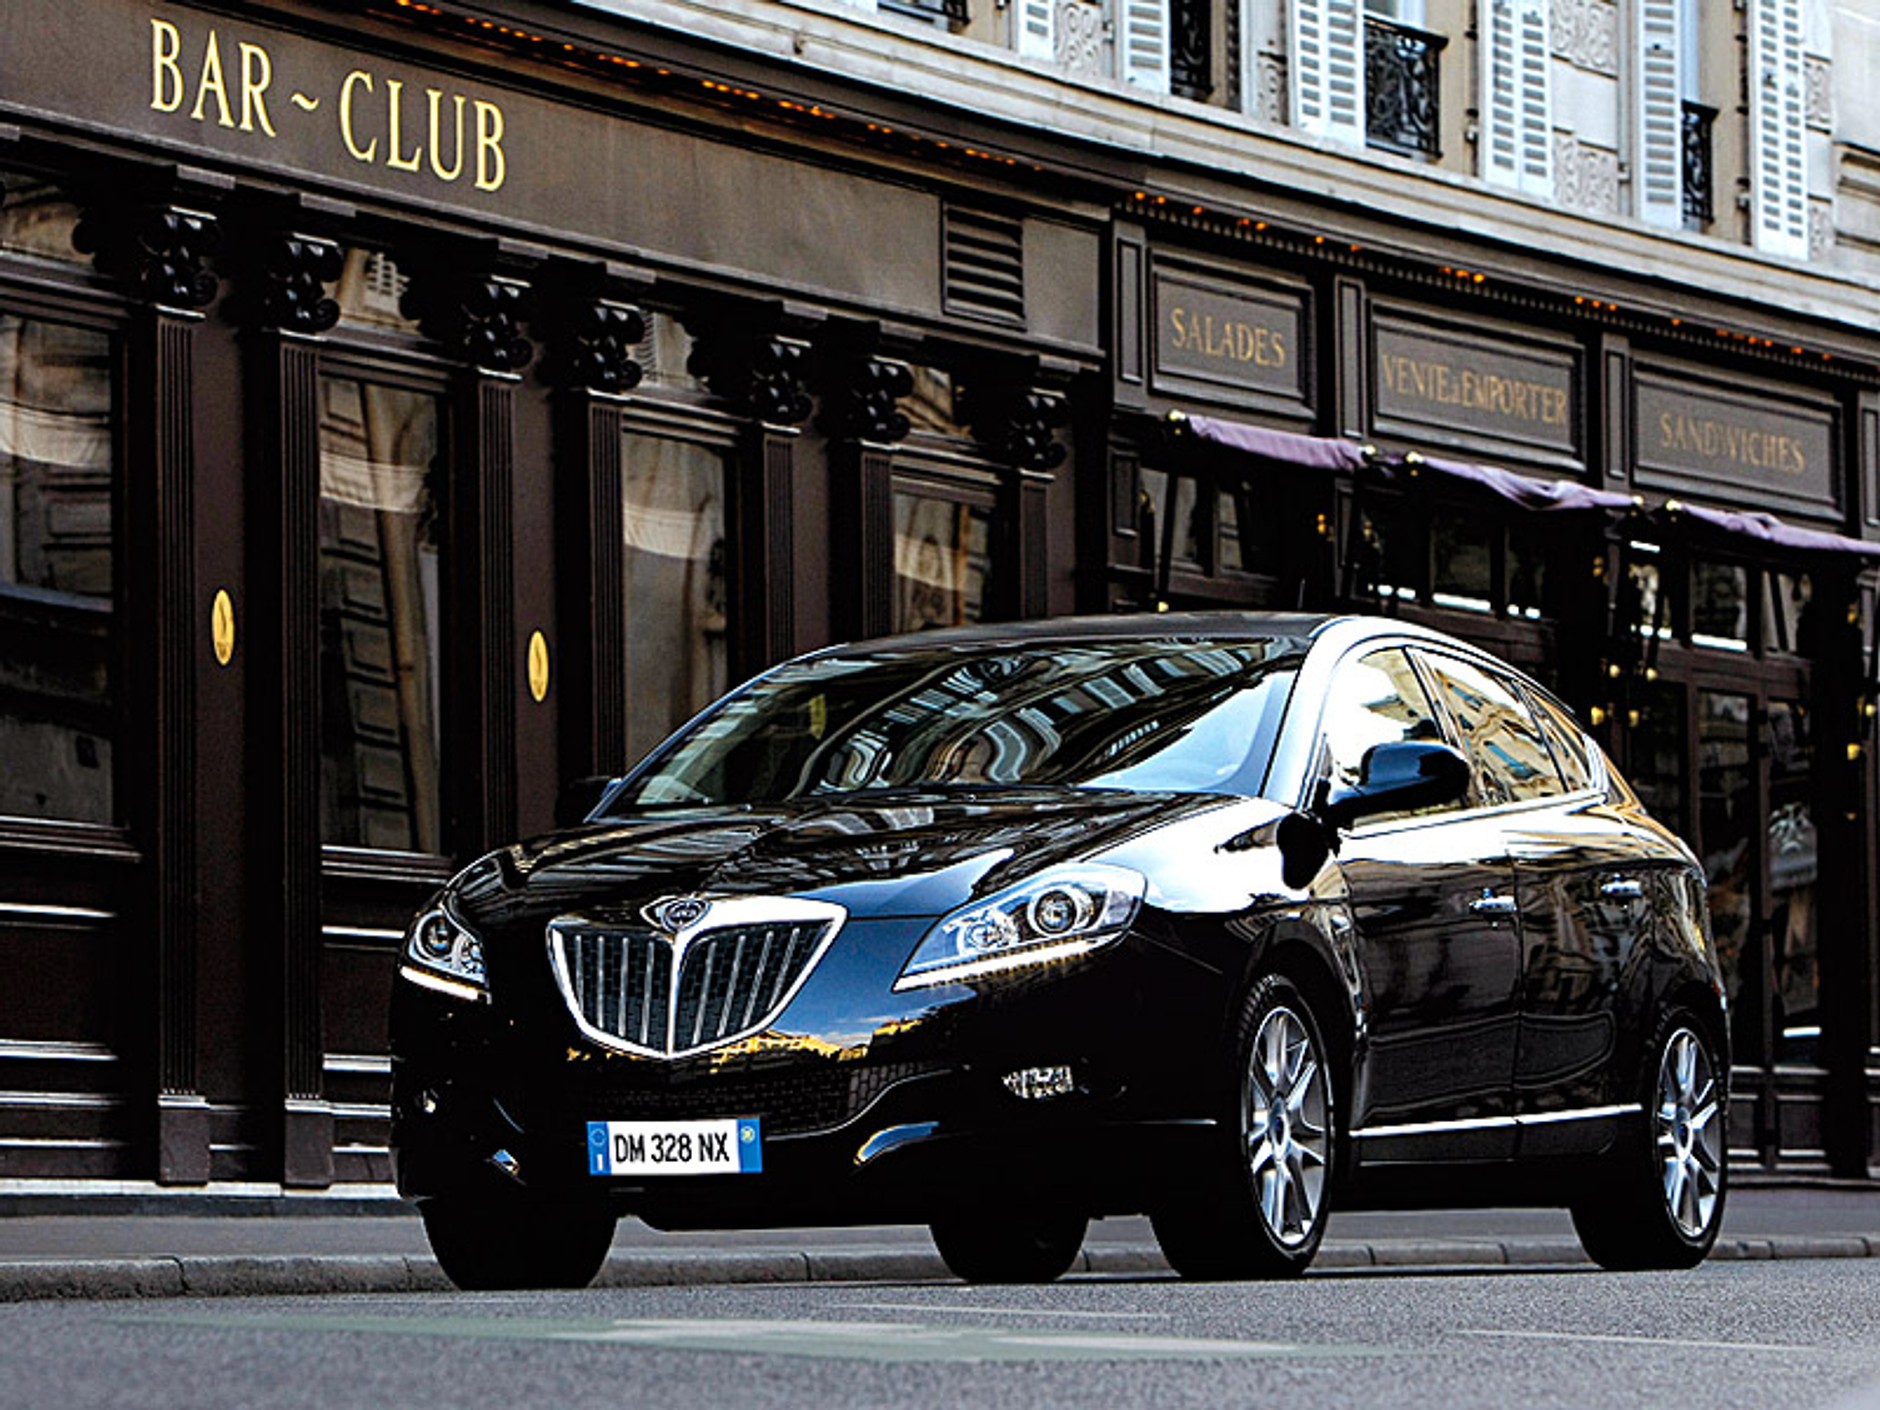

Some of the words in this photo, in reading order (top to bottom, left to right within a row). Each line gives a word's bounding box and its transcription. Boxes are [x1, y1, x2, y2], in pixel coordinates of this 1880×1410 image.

[150, 18, 276, 138] BAR
[339, 70, 506, 192] CLUB
[1170, 307, 1286, 368] SALADES
[1382, 354, 1451, 403] VENTE
[1660, 411, 1806, 475] SANDWICHES
[614, 1134, 645, 1163] DM
[651, 1133, 692, 1164] 328
[698, 1131, 730, 1163] NX
